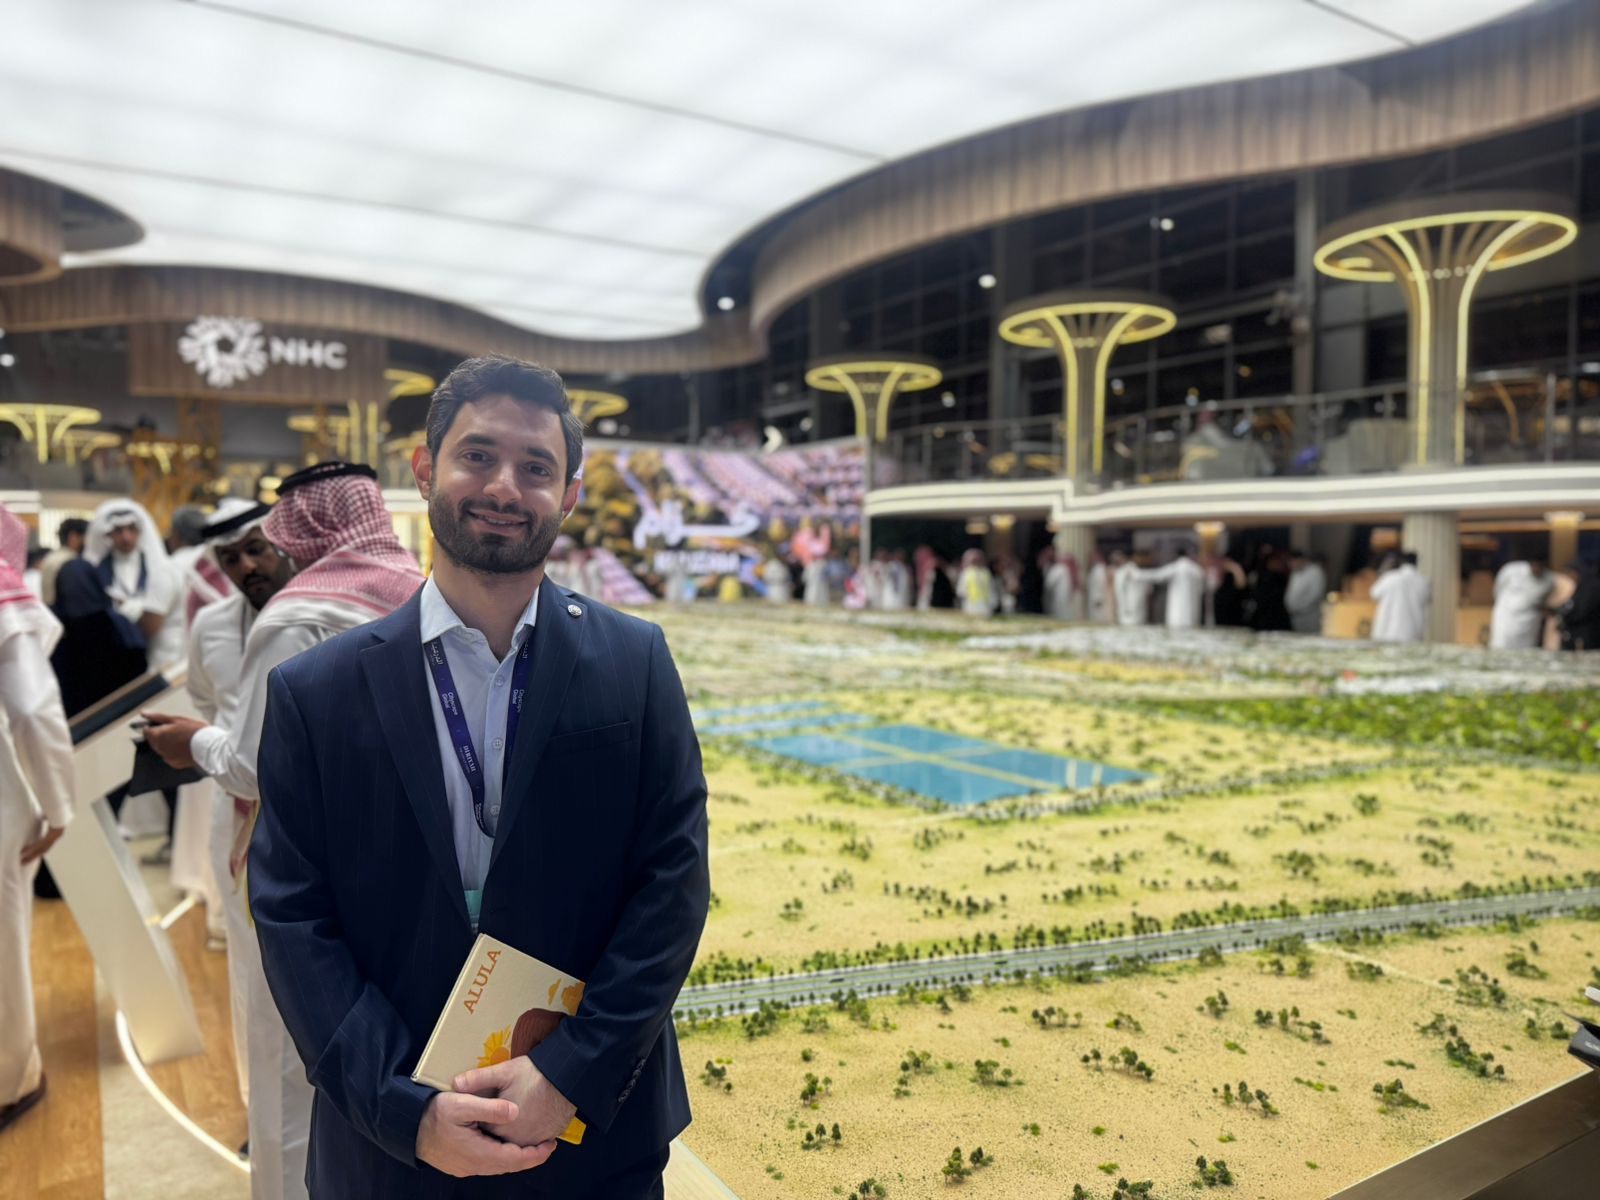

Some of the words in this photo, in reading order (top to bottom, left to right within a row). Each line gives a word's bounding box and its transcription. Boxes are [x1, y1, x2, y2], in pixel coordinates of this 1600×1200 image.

[269, 336, 348, 371] NHC
[447, 691, 458, 715] Cityscape
[463, 745, 477, 771] DIRIYAH
[463, 950, 502, 1015] ALULA
